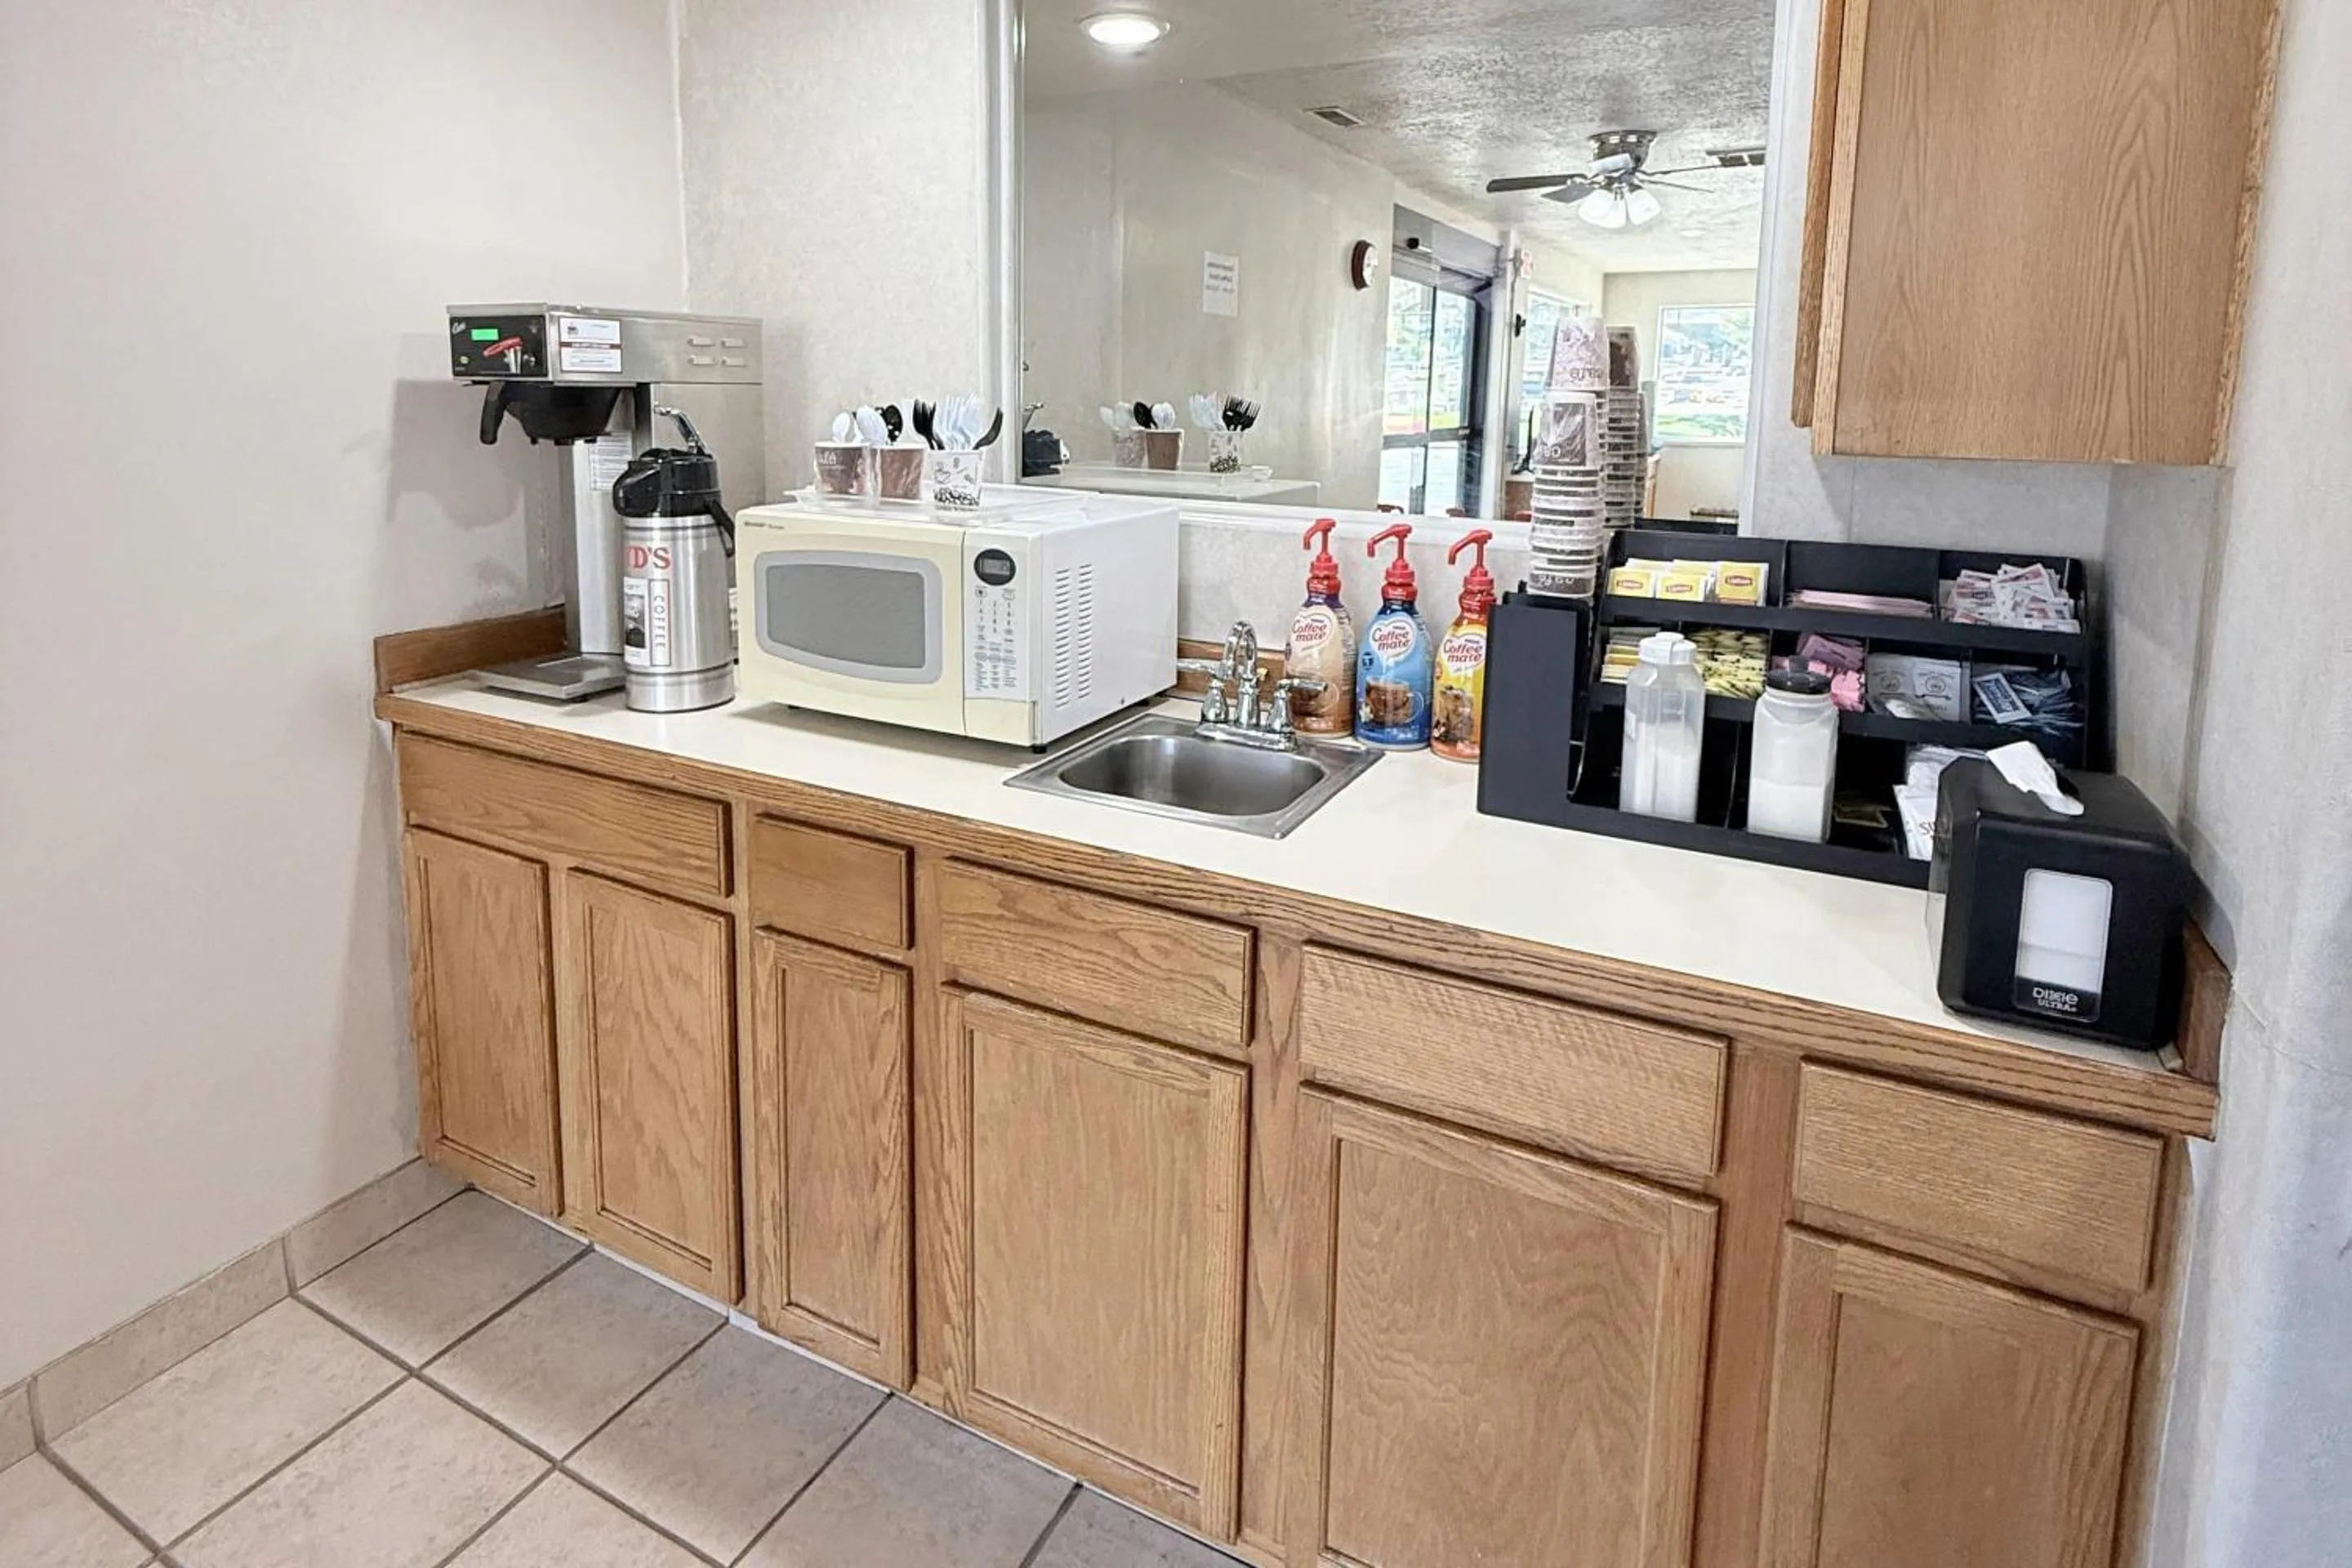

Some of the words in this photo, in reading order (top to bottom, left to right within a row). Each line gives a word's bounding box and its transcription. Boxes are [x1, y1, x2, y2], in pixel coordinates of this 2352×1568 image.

[653, 595, 666, 649] COFFEE
[1292, 618, 1327, 634] Coffee
[1295, 632, 1327, 642] mate
[1372, 627, 1410, 642] Coffee
[1378, 639, 1410, 651] mate
[1444, 639, 1483, 653] Coffee
[1447, 653, 1482, 662] mate
